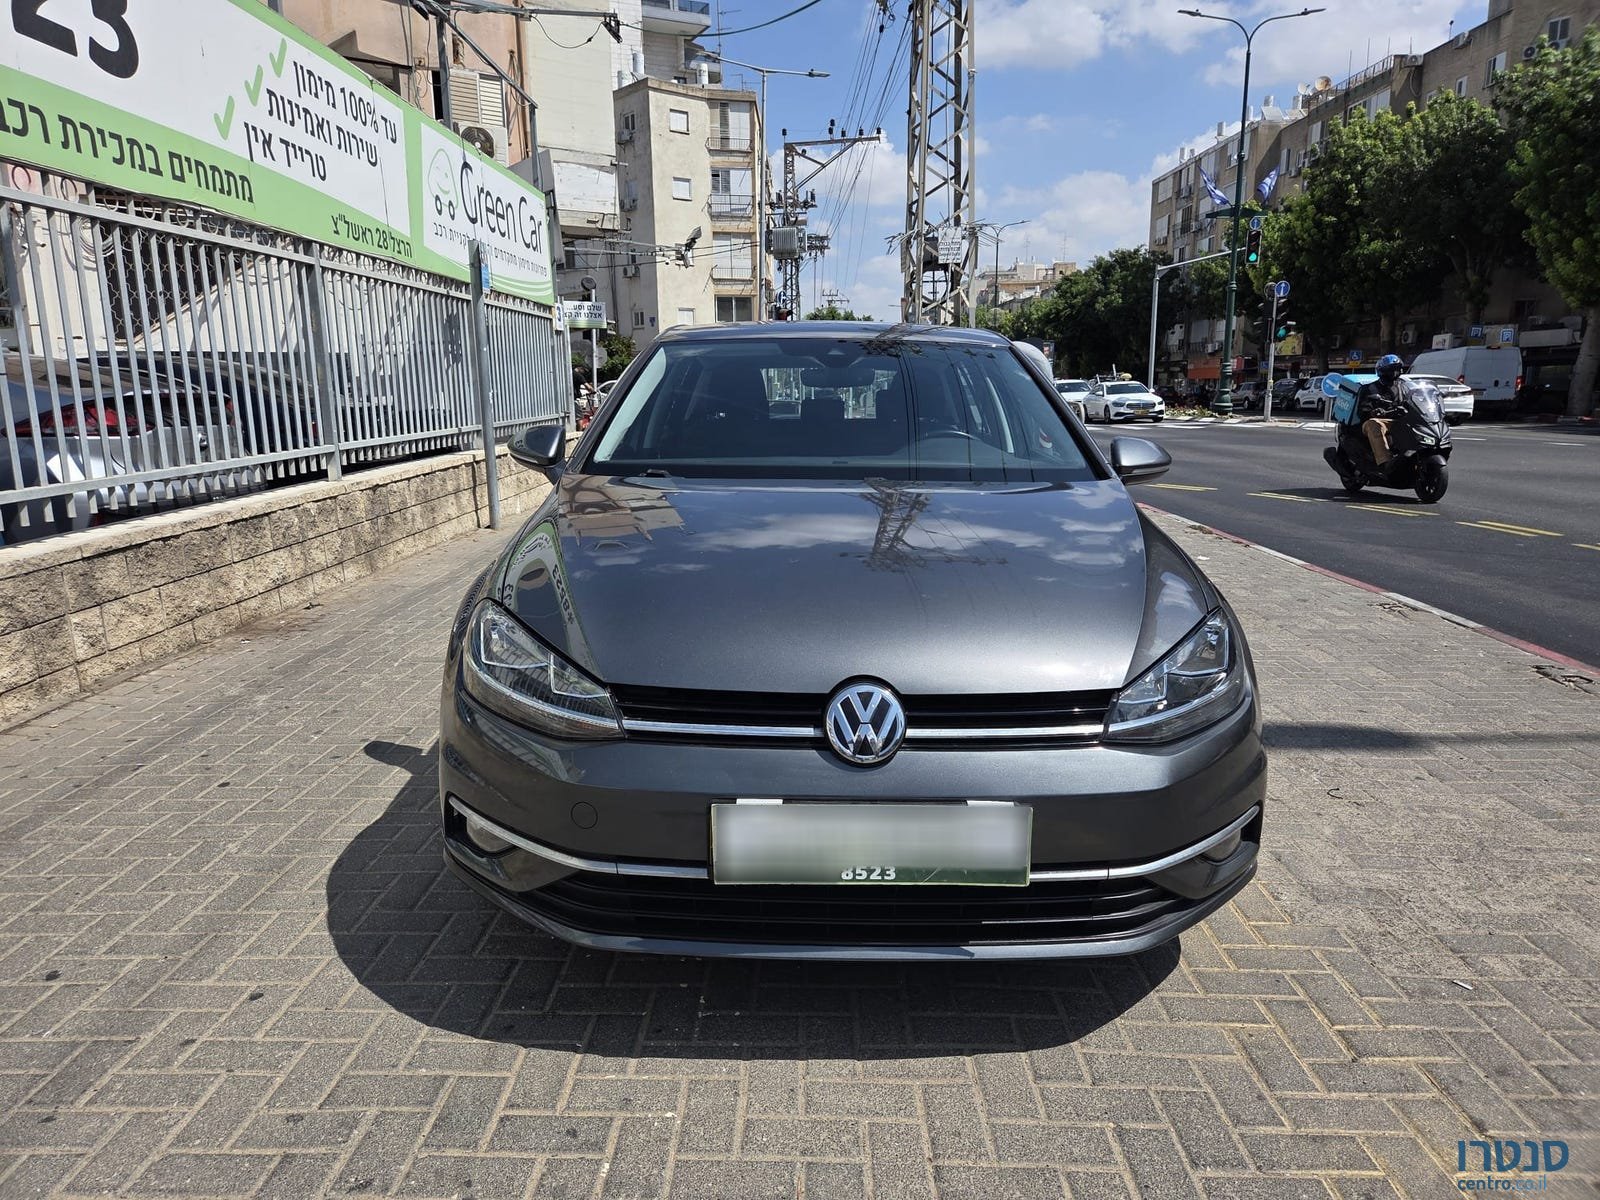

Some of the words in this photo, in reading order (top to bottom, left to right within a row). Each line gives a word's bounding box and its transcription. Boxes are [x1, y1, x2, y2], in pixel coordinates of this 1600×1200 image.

[293, 61, 337, 110] מימון
[266, 88, 333, 146] ואמינות
[340, 87, 379, 133] 100%
[381, 115, 398, 144] עד
[57, 113, 164, 177] במכירת
[244, 121, 276, 162] אין
[279, 137, 327, 182] טרייד
[336, 125, 378, 167] שירות
[168, 150, 255, 203] מתמחים
[460, 161, 517, 243] Green
[518, 196, 542, 254] Car
[375, 227, 389, 250] 28
[389, 231, 413, 258] הרצל
